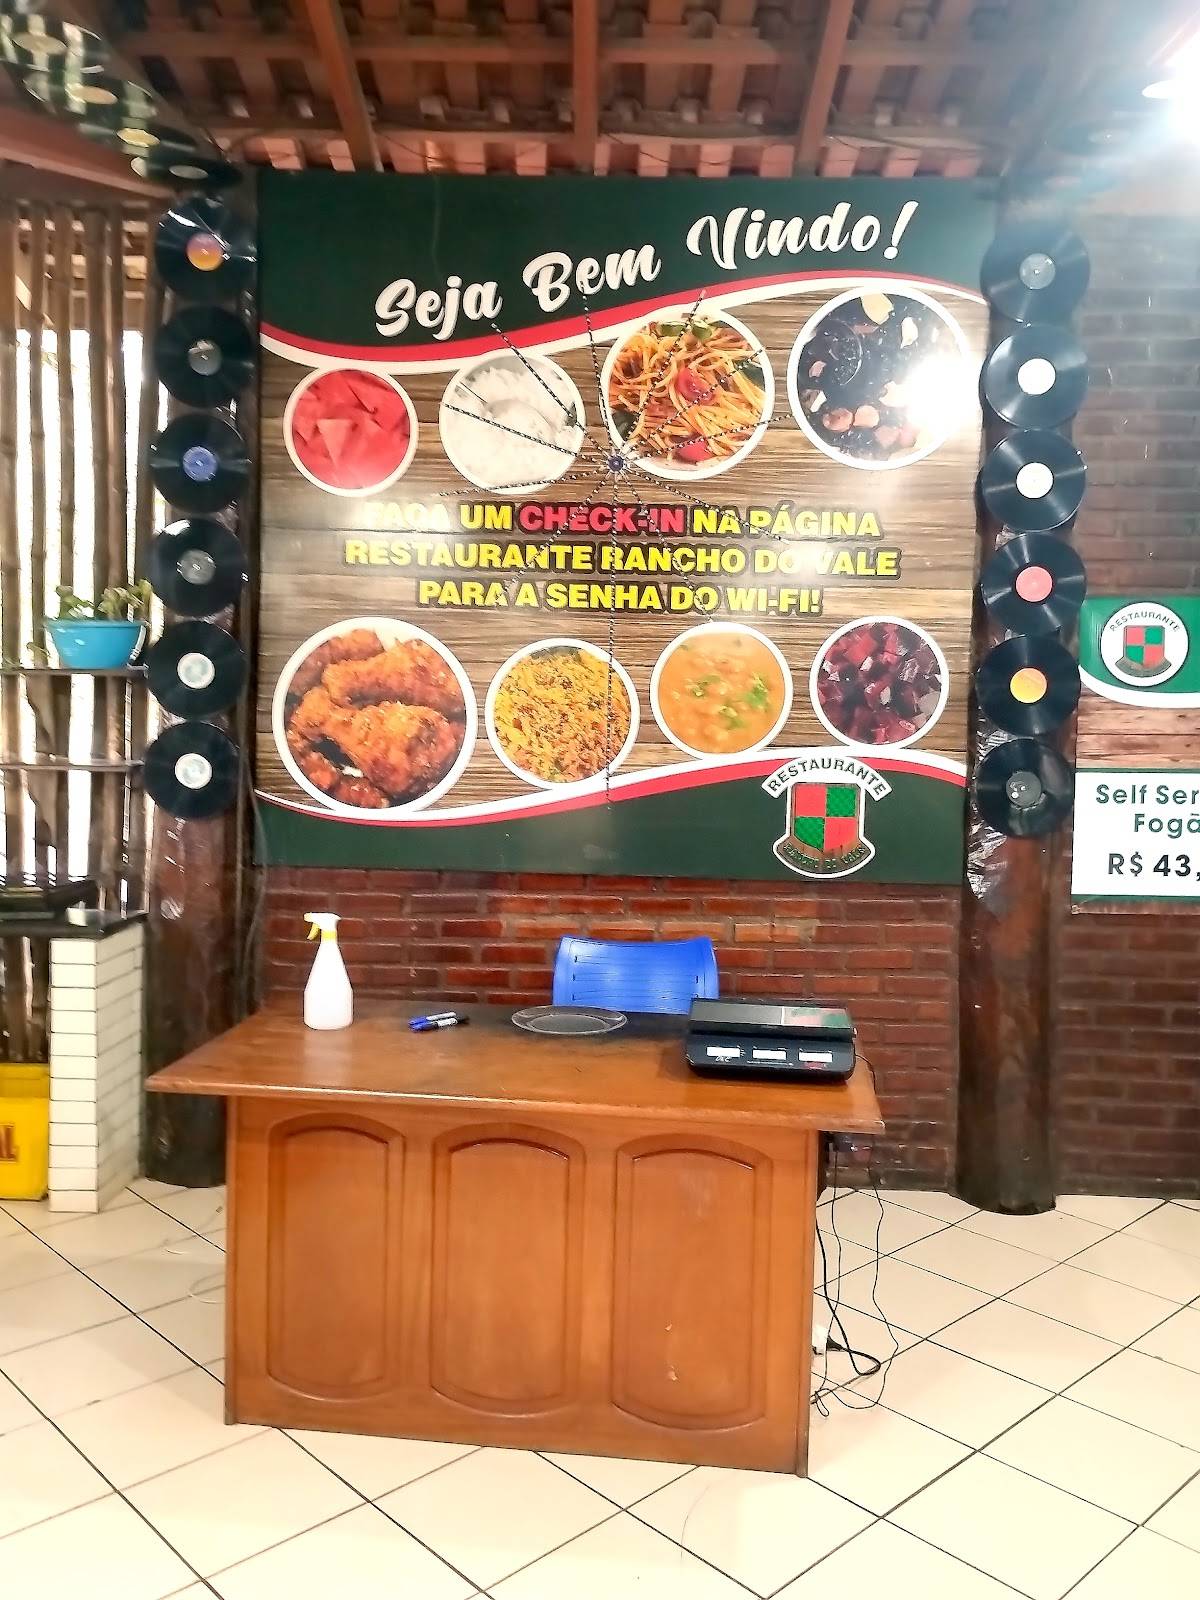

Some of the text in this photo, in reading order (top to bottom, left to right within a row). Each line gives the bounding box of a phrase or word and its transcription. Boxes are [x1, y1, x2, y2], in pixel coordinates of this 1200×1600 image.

[374, 200, 919, 341] Seja Bem Vindo!
[460, 504, 512, 529] UM
[519, 505, 684, 533] CHECK-IN
[693, 509, 741, 534] NA
[749, 504, 880, 537] PÁGINA
[345, 539, 593, 570] RESTAURANTE
[601, 545, 745, 573] RANCHO
[419, 580, 820, 613] PARA A SENHA DO WI-FI!
[1109, 611, 1181, 633] RESTAURANTE
[767, 757, 887, 796] RESTAURANTE
[1095, 783, 1200, 805] Self Ser
[1108, 851, 1144, 878] R$
